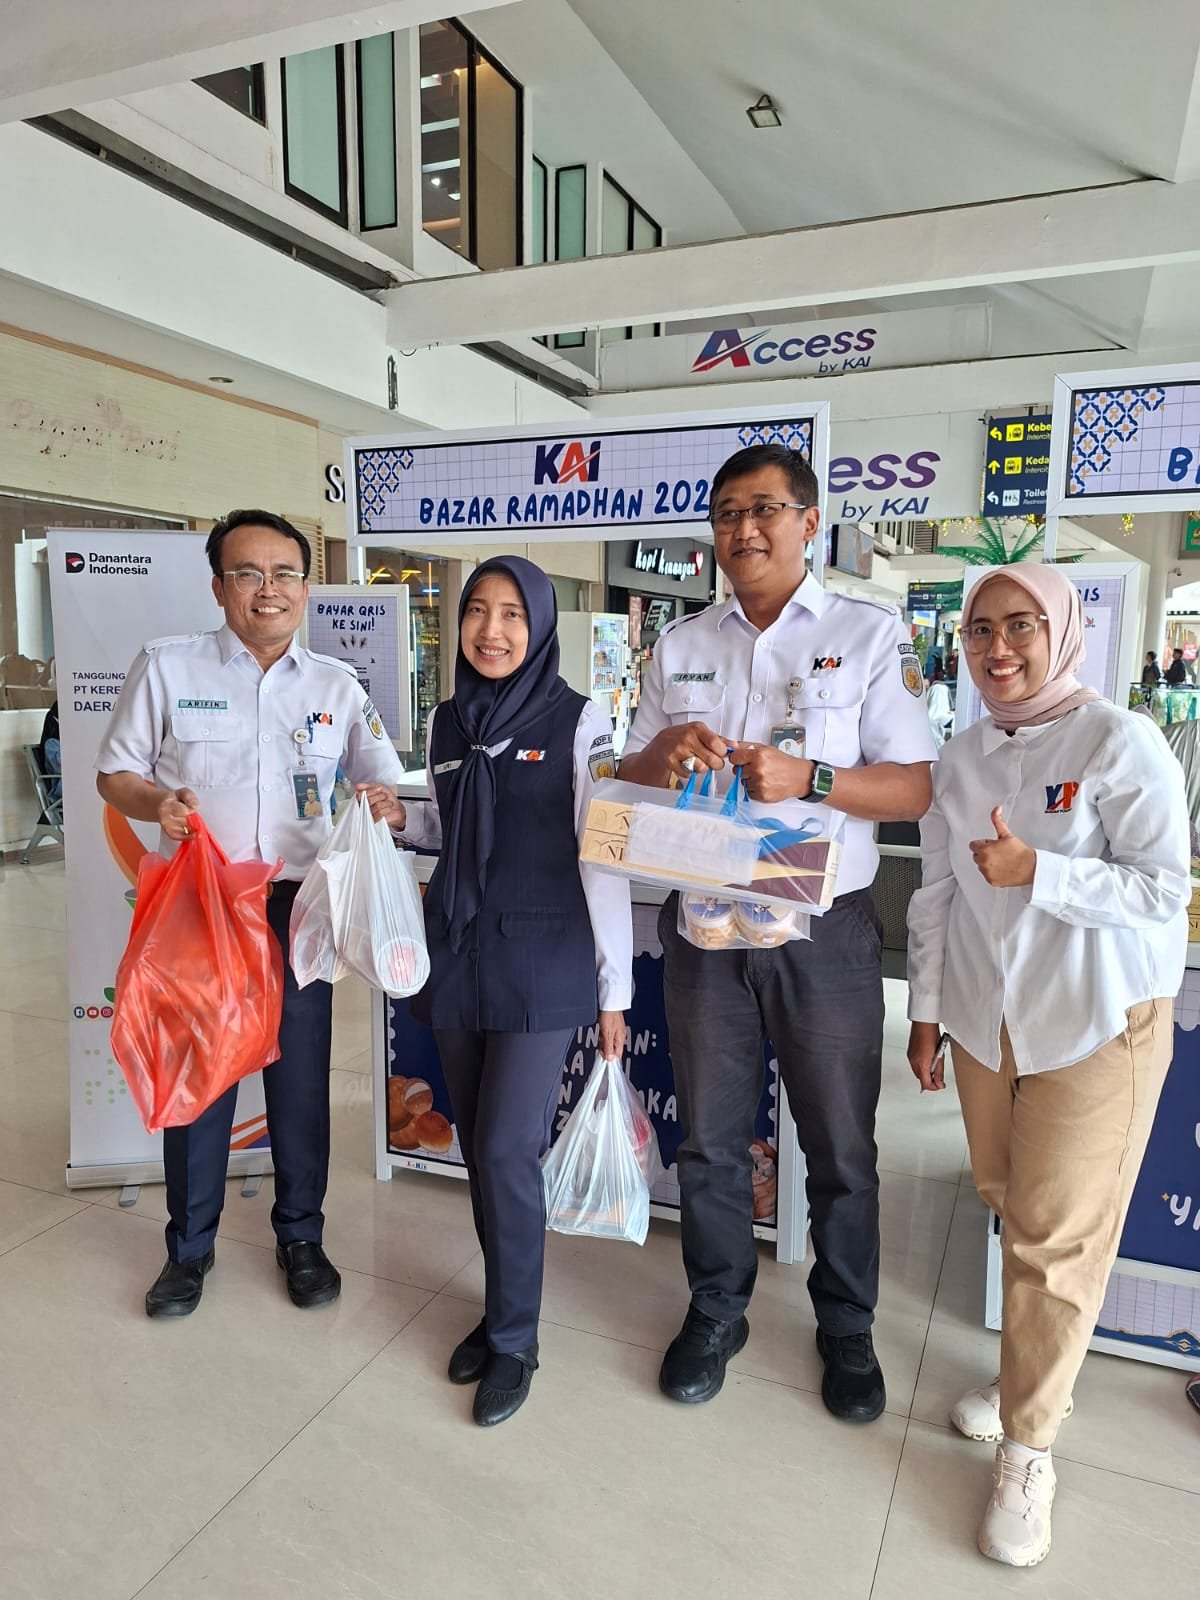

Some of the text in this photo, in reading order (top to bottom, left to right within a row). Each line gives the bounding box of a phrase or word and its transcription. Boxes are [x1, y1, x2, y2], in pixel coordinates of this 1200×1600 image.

[690, 327, 877, 373] Access
[819, 356, 871, 373] by KAI
[534, 441, 601, 485] KAI
[419, 497, 497, 526] BAZAR
[506, 487, 643, 525] RAMADHAN
[841, 497, 929, 521] by KAI
[89, 552, 152, 564] Danantara
[89, 564, 148, 575] Indonesia
[1078, 587, 1100, 602] IS
[317, 603, 385, 616] BAYAR QRIS
[332, 617, 375, 632] KE SINI!
[72, 672, 126, 680] TANGGUNG
[74, 685, 88, 695] PT
[74, 701, 116, 712] DAER
